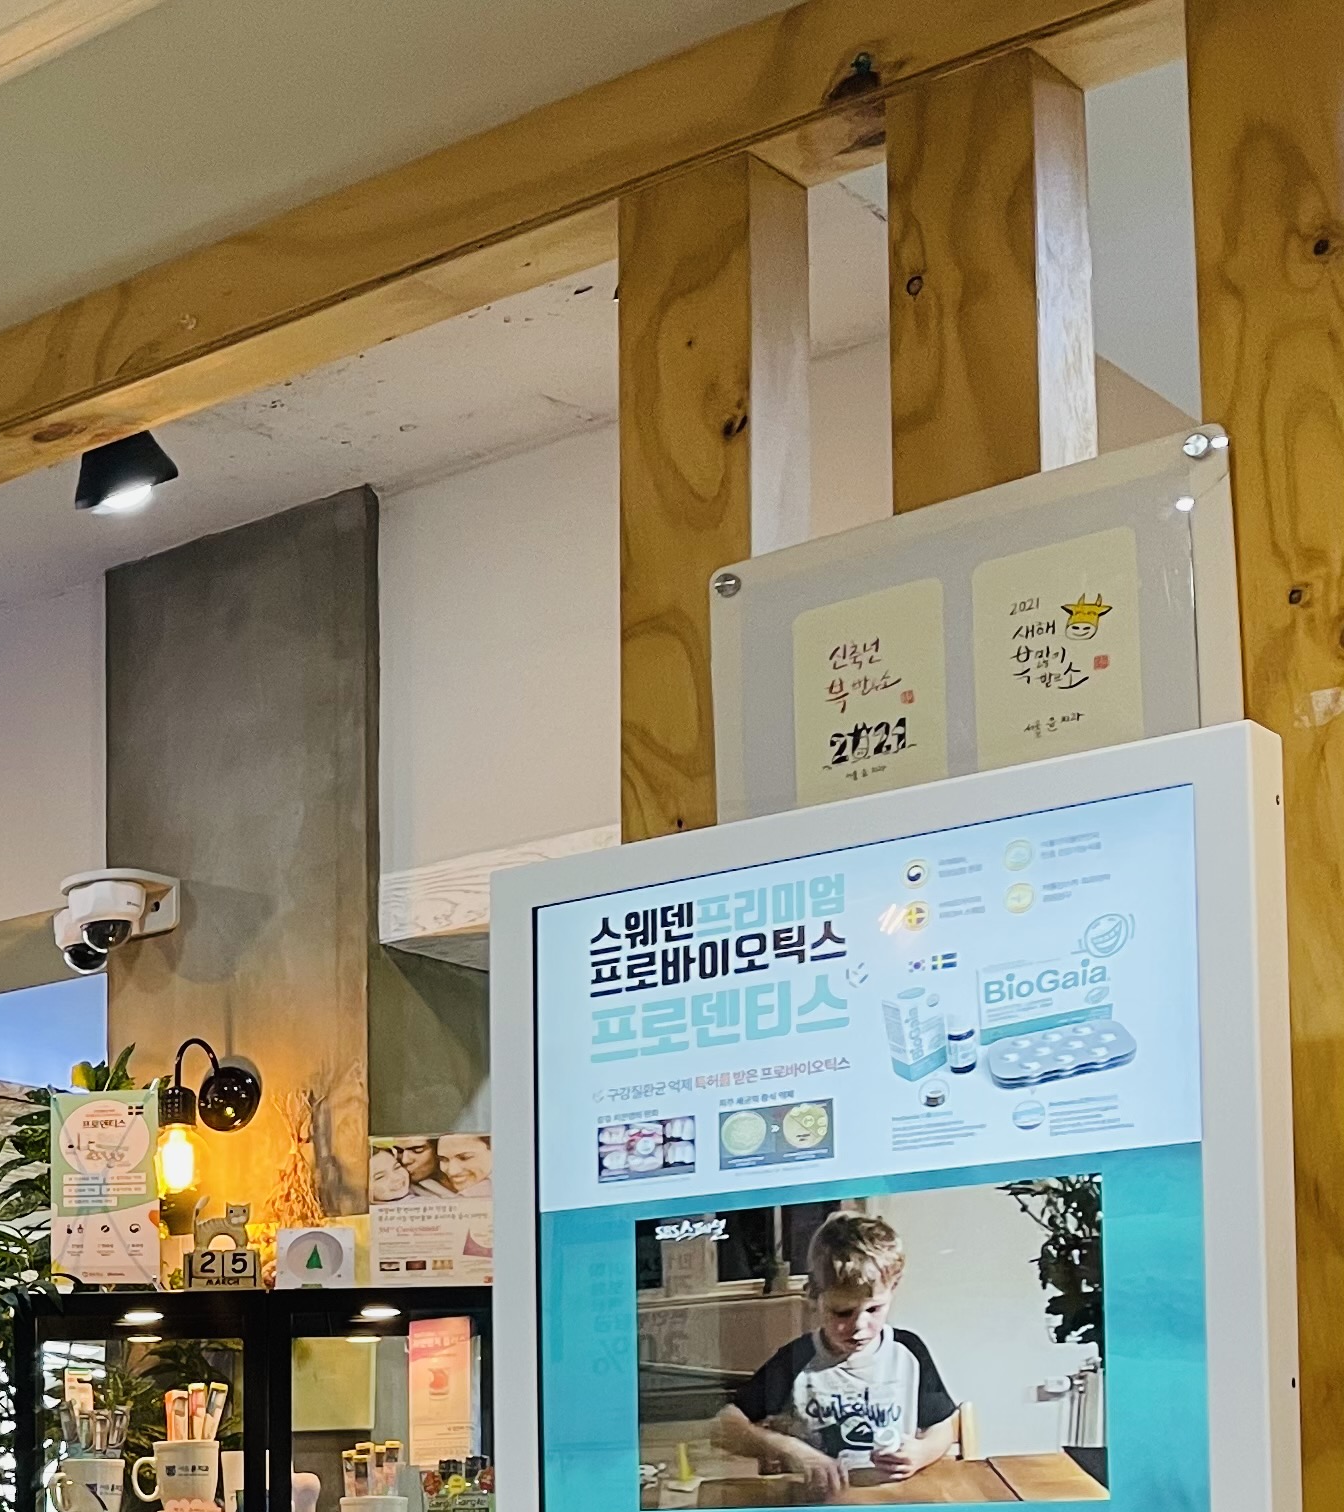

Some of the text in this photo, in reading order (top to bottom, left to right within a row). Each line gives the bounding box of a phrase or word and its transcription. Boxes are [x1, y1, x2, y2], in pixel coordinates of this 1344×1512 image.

[1010, 597, 1041, 616] 2021
[1012, 619, 1056, 640] 새해
[828, 637, 883, 671] 신축년
[590, 920, 848, 998] 프로바이오틱스
[984, 958, 1109, 1004] BioGaia
[590, 973, 851, 1064] 프로덴티스
[606, 1081, 667, 1103] 구강질환균
[669, 1077, 693, 1093] 억제
[733, 1067, 758, 1084] 받은
[759, 1055, 852, 1081] 프로바이오틱스
[200, 1251, 248, 1279] 2 5
[205, 1277, 241, 1287] MARCH
